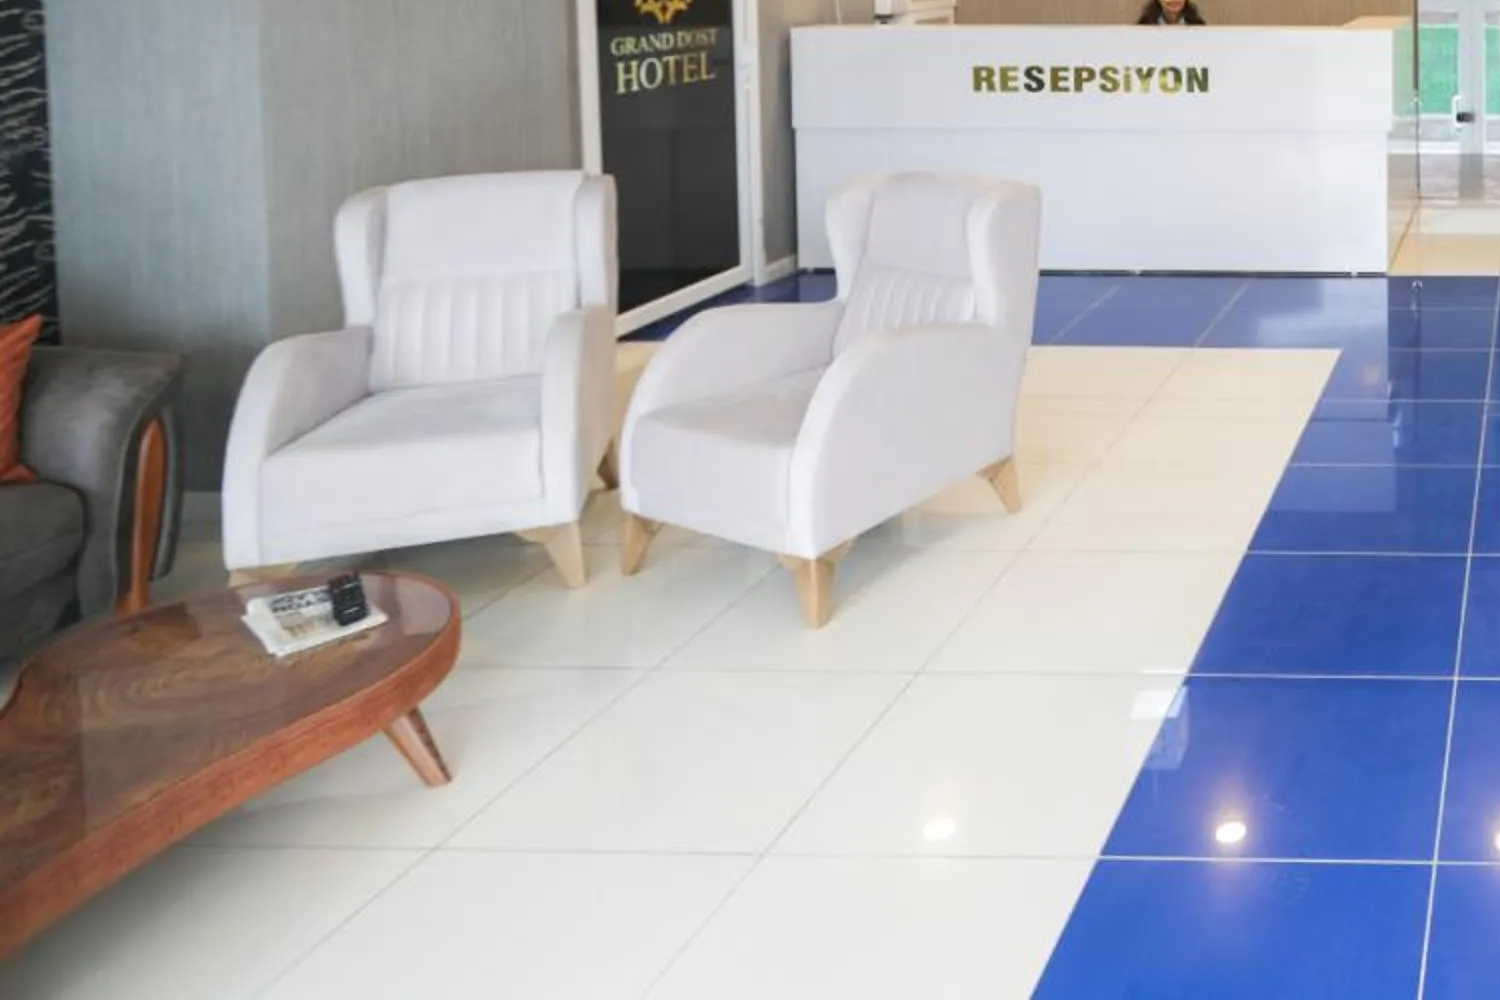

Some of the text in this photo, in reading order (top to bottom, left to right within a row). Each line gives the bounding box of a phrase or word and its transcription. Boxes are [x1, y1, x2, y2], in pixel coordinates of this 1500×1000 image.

[611, 28, 719, 56] GRAND DOST
[616, 51, 717, 95] HOTEL
